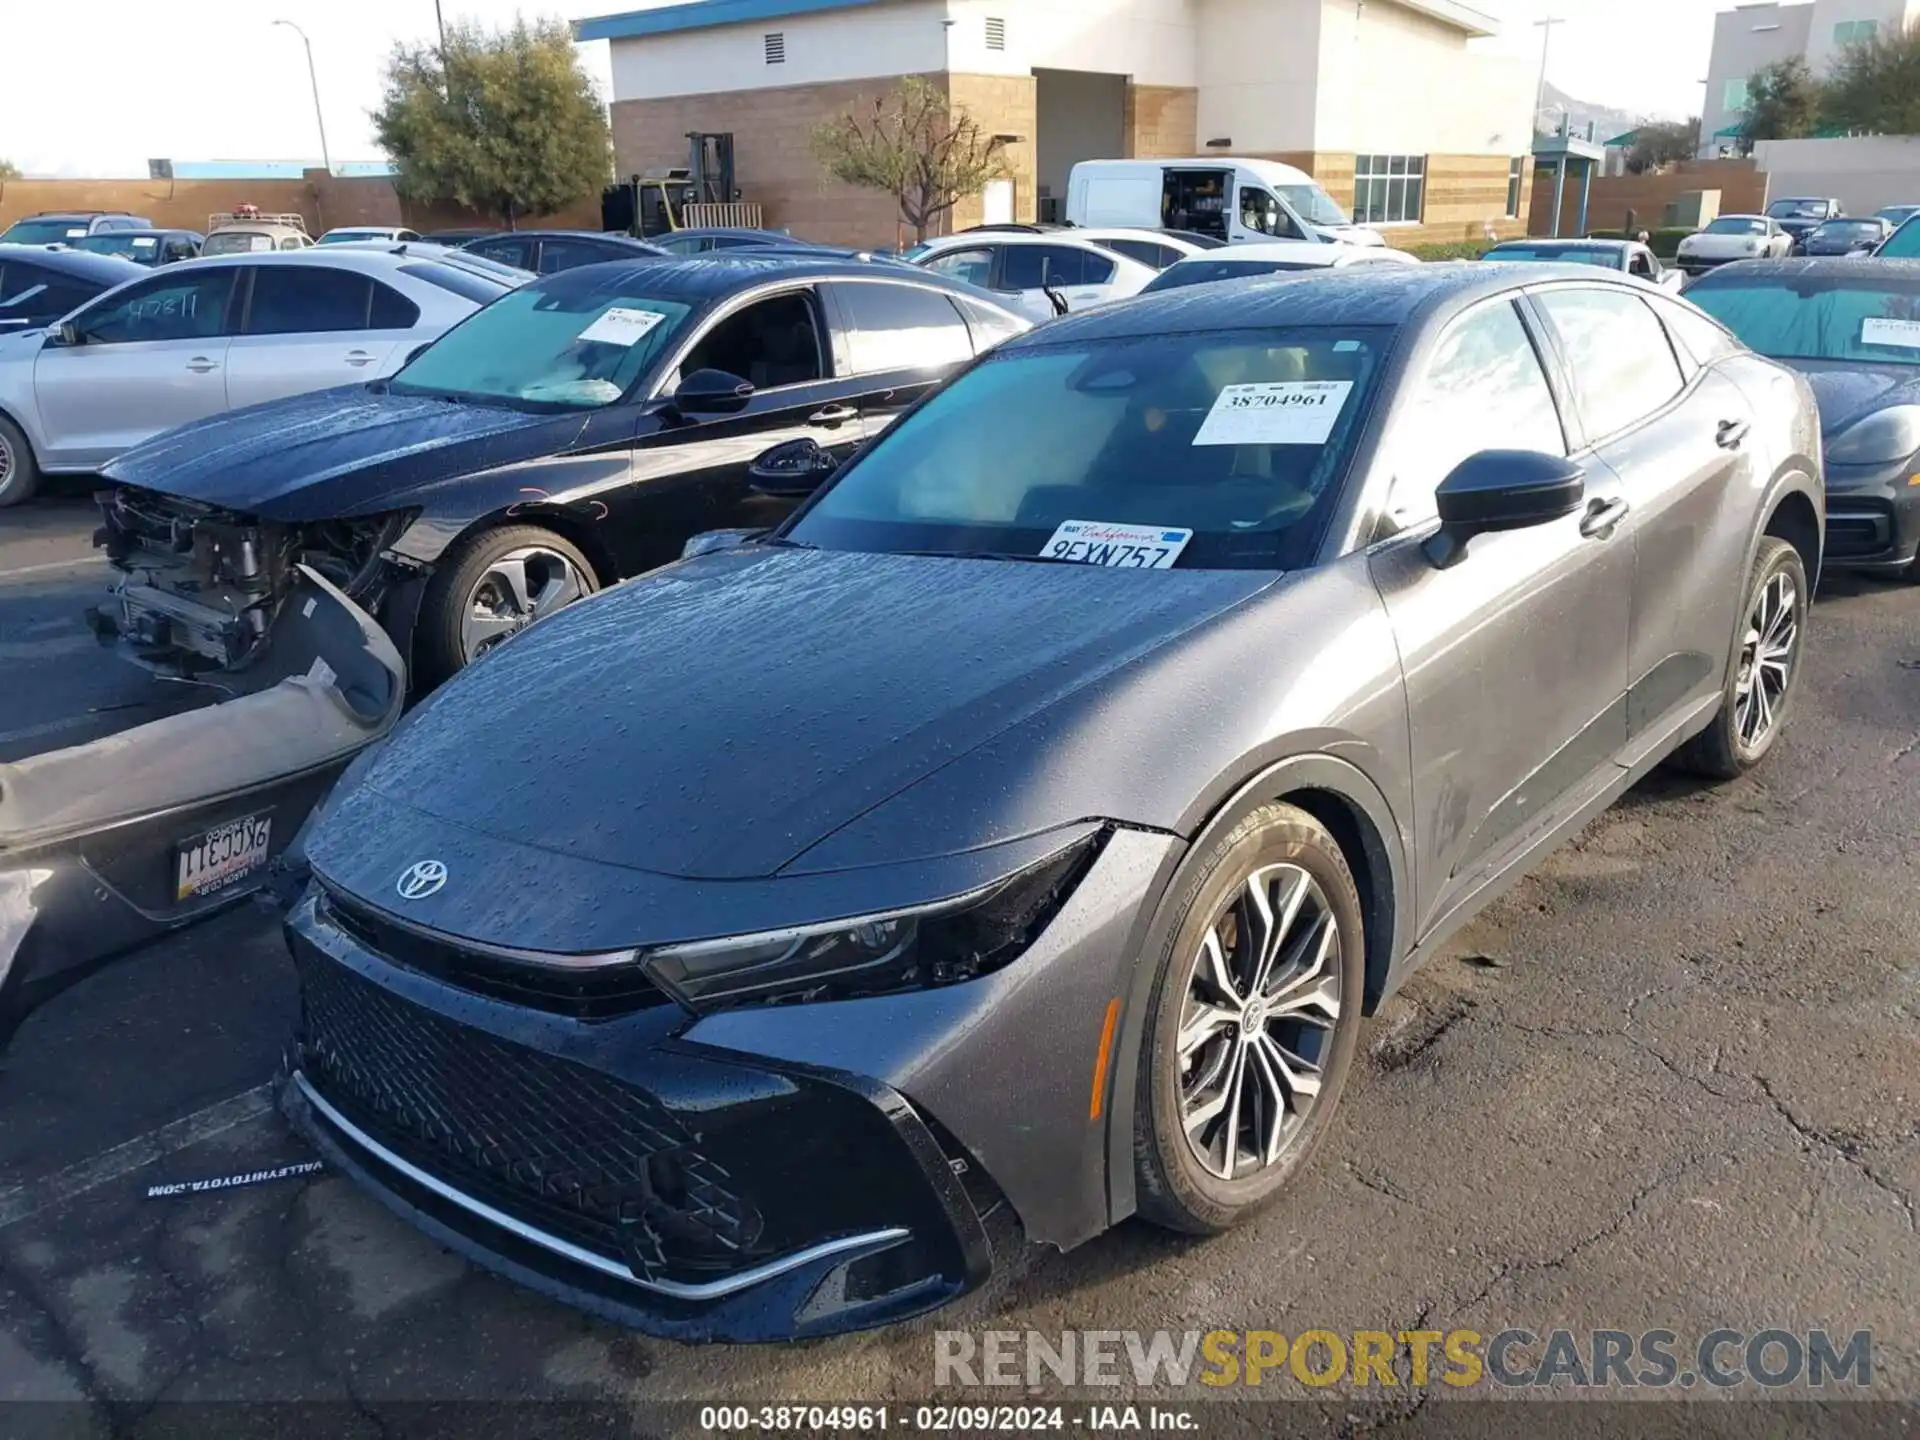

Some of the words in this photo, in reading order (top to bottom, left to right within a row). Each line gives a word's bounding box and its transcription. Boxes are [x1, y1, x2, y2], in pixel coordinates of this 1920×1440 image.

[1226, 394, 1328, 409] 38704961
[1081, 525, 1161, 542] California
[1053, 540, 1170, 568] 9EXN757
[186, 824, 267, 878] 9KCC311
